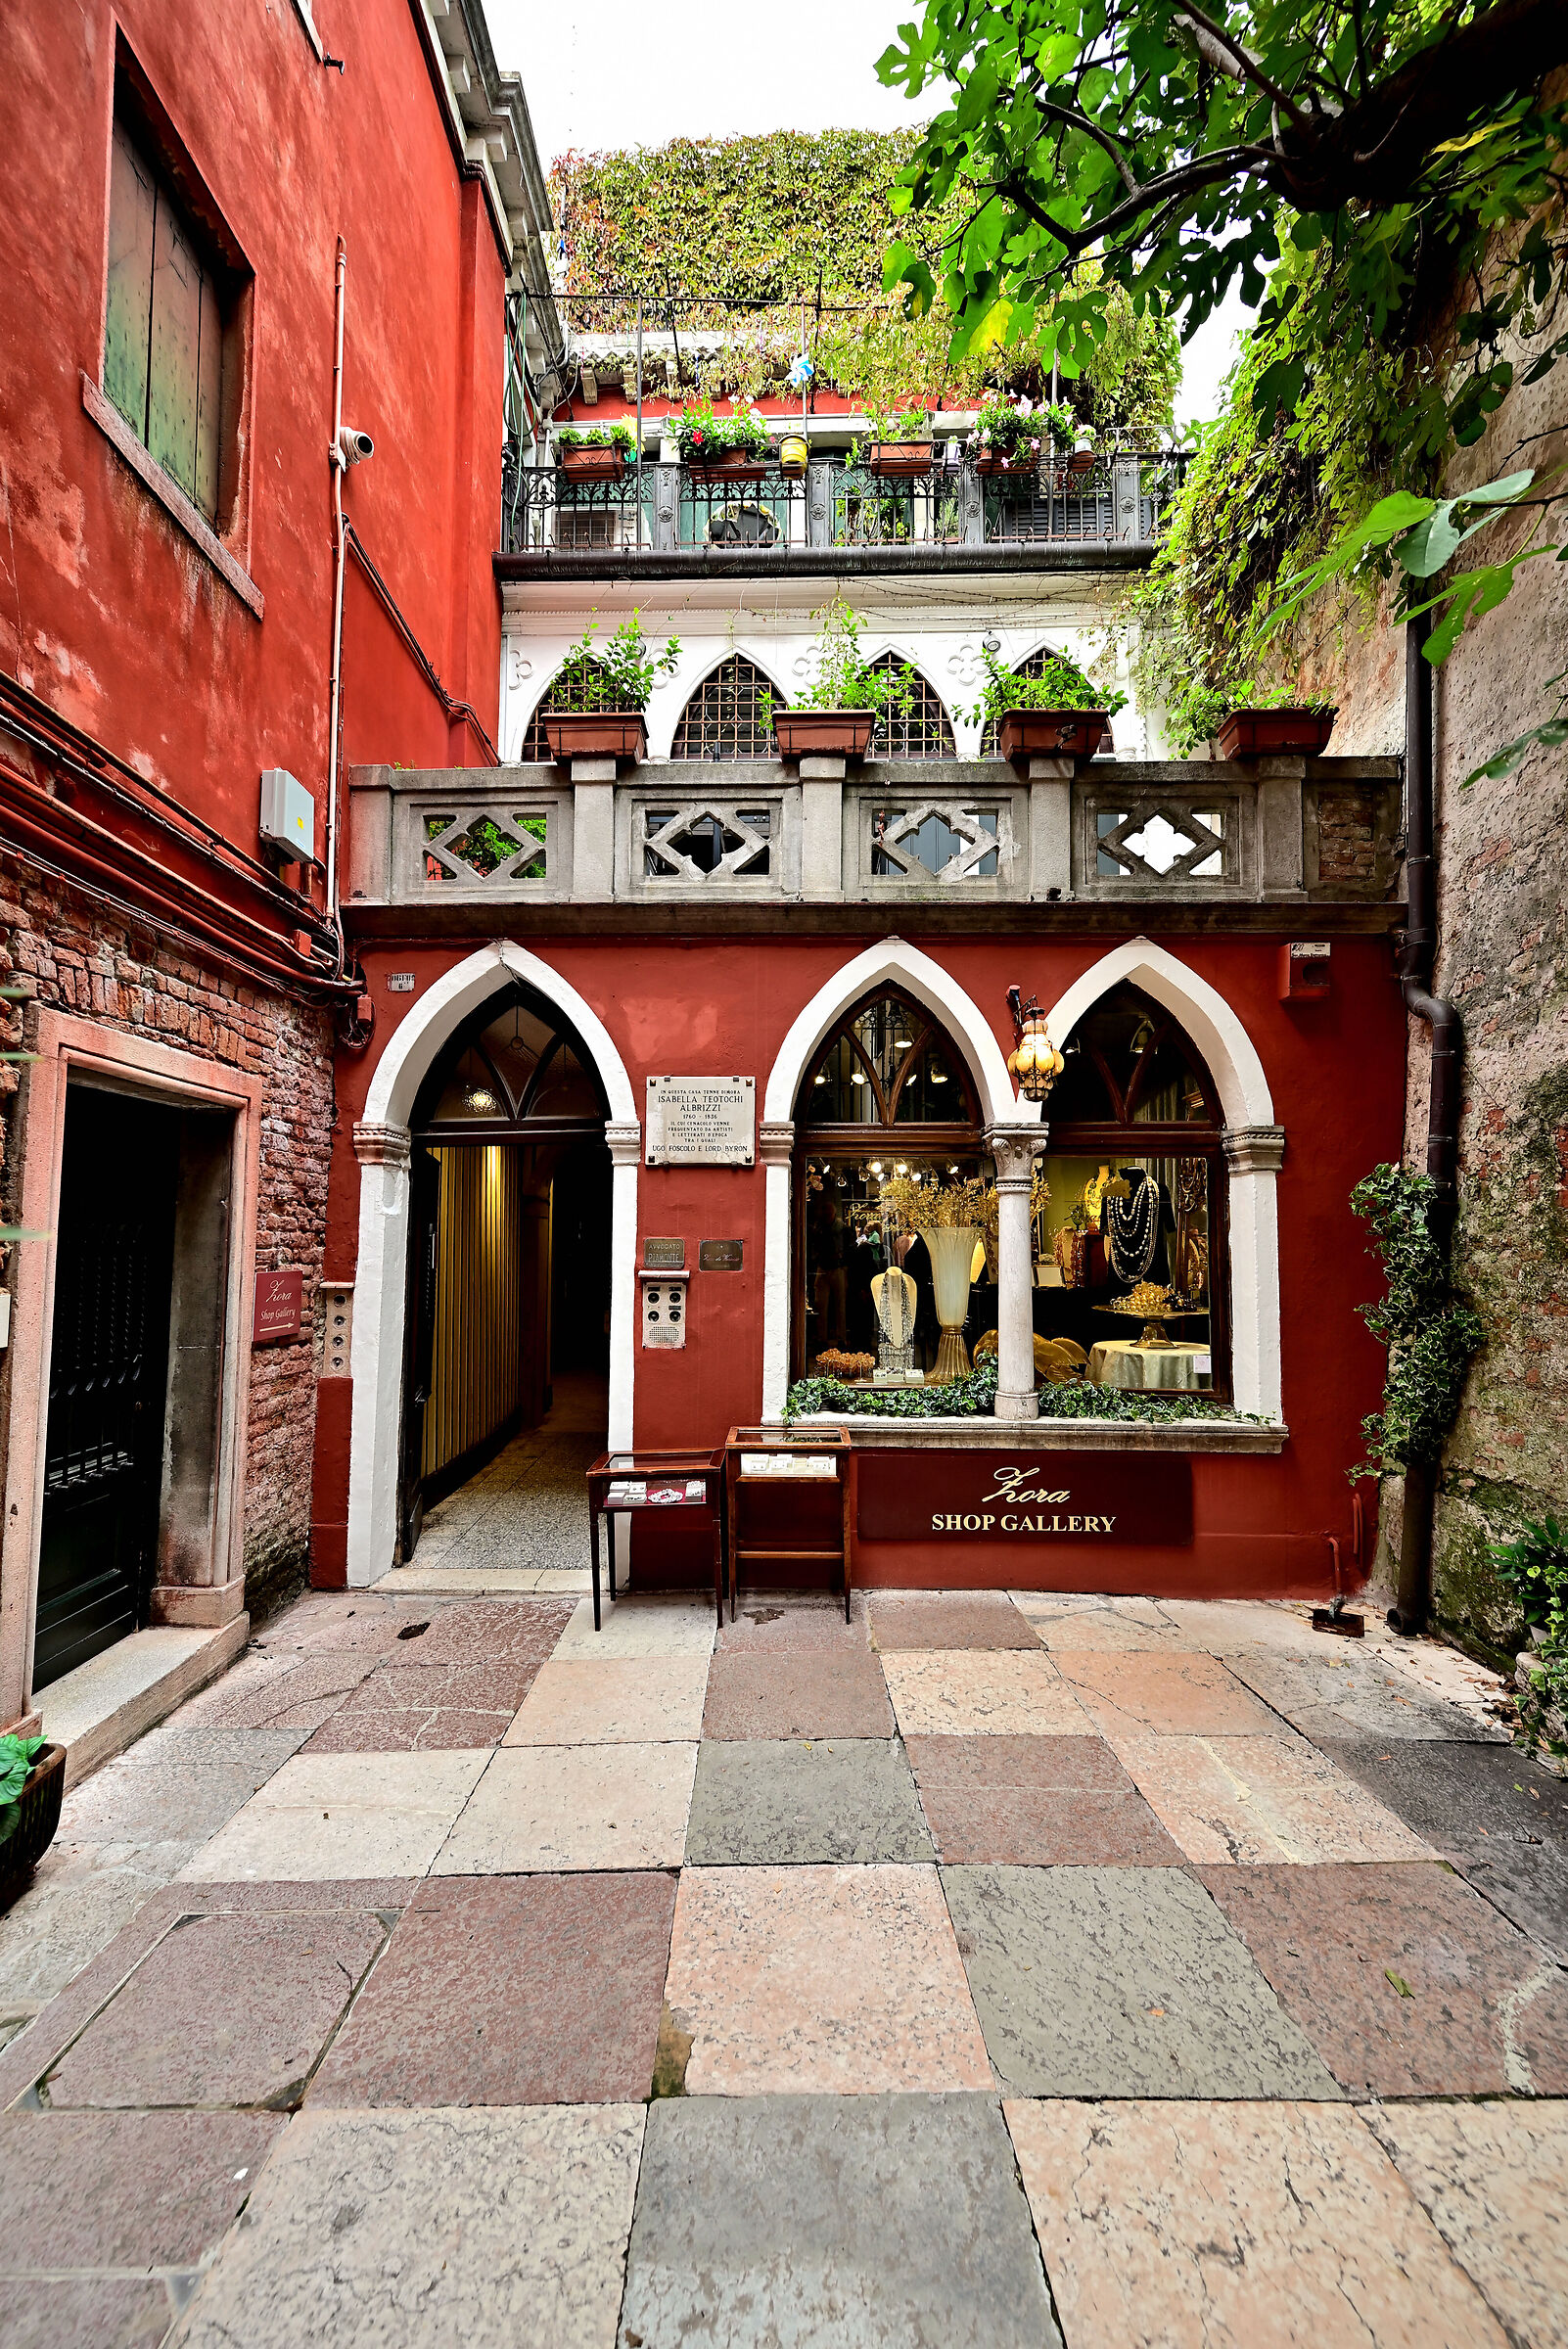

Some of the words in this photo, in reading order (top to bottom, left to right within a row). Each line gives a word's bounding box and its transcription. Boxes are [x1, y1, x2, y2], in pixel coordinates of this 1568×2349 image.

[266, 1280, 292, 1302] Zora
[260, 1309, 275, 1323] Shop
[275, 1307, 296, 1319] Gallery
[982, 1467, 1070, 1503] Zora
[932, 1514, 995, 1531] SHOP
[1000, 1515, 1117, 1533] GALLERY
